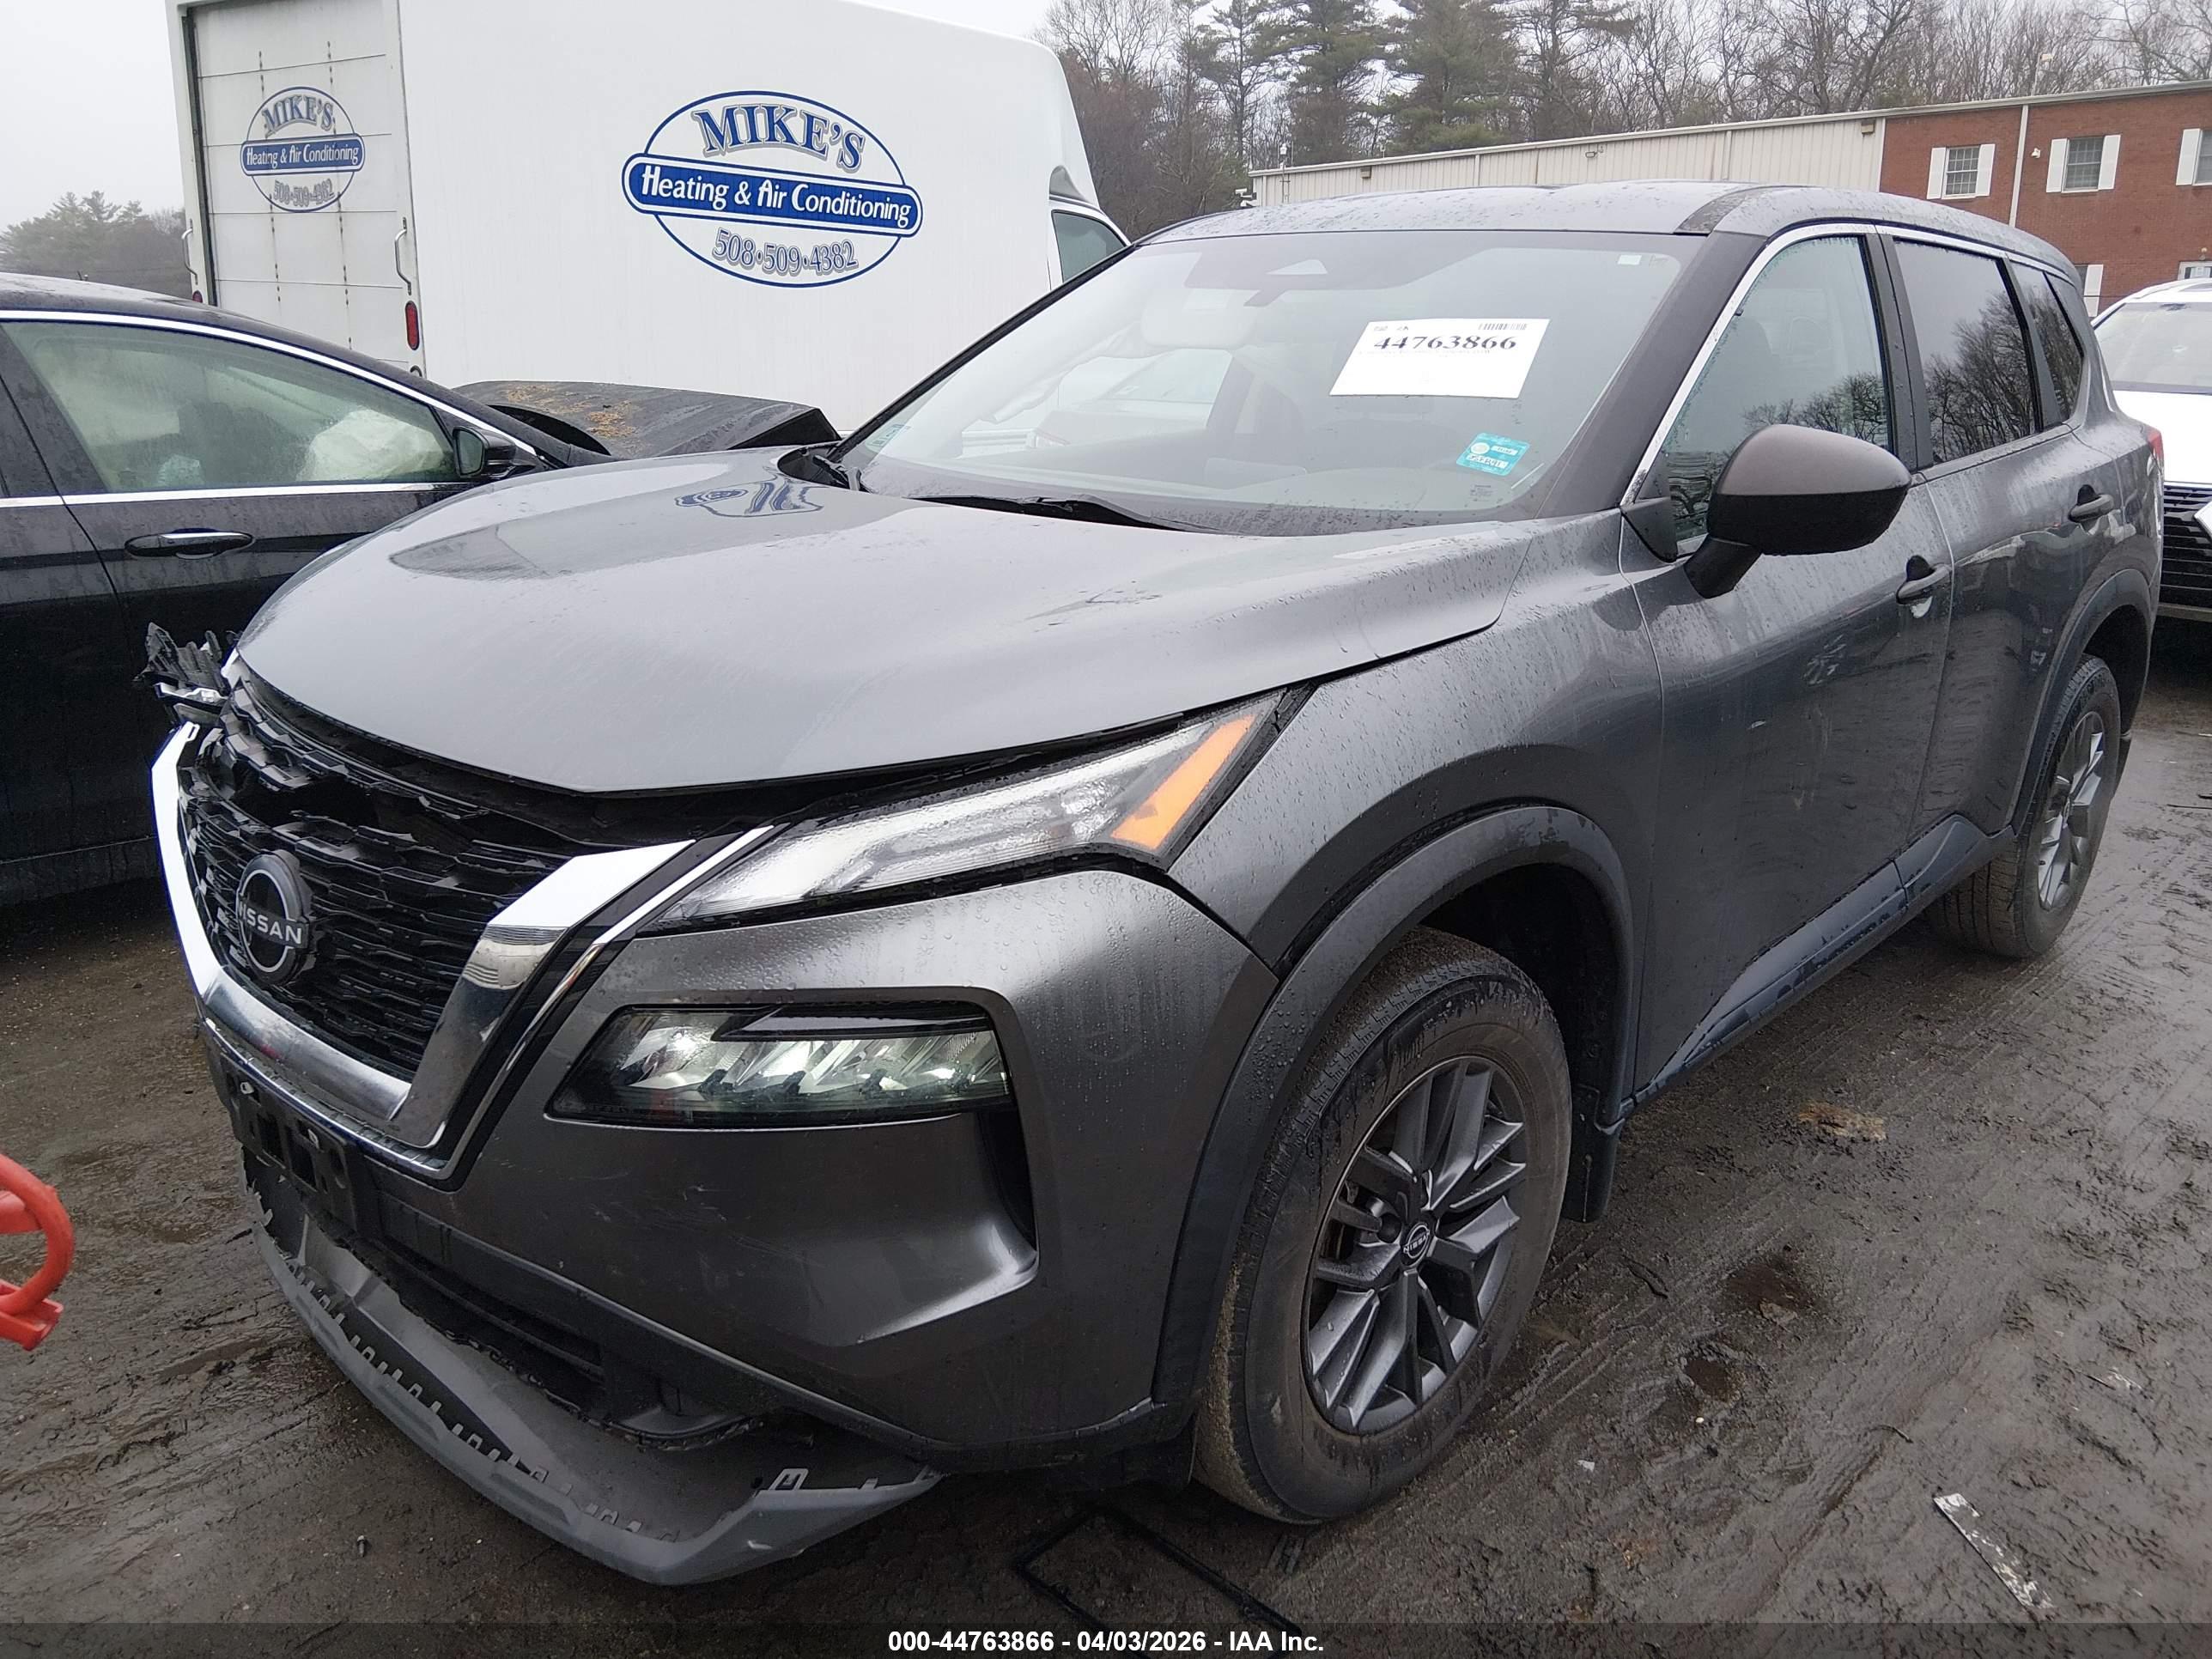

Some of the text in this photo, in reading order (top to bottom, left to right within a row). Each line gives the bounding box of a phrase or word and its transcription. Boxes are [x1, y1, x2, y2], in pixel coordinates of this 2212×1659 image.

[262, 94, 335, 137] MIKE'S
[246, 142, 359, 169] Heating & Air Conditioning
[691, 104, 866, 173] MIKE'S
[642, 165, 912, 228] Heating & Air Conditioning
[1374, 335, 1517, 349] 44763866
